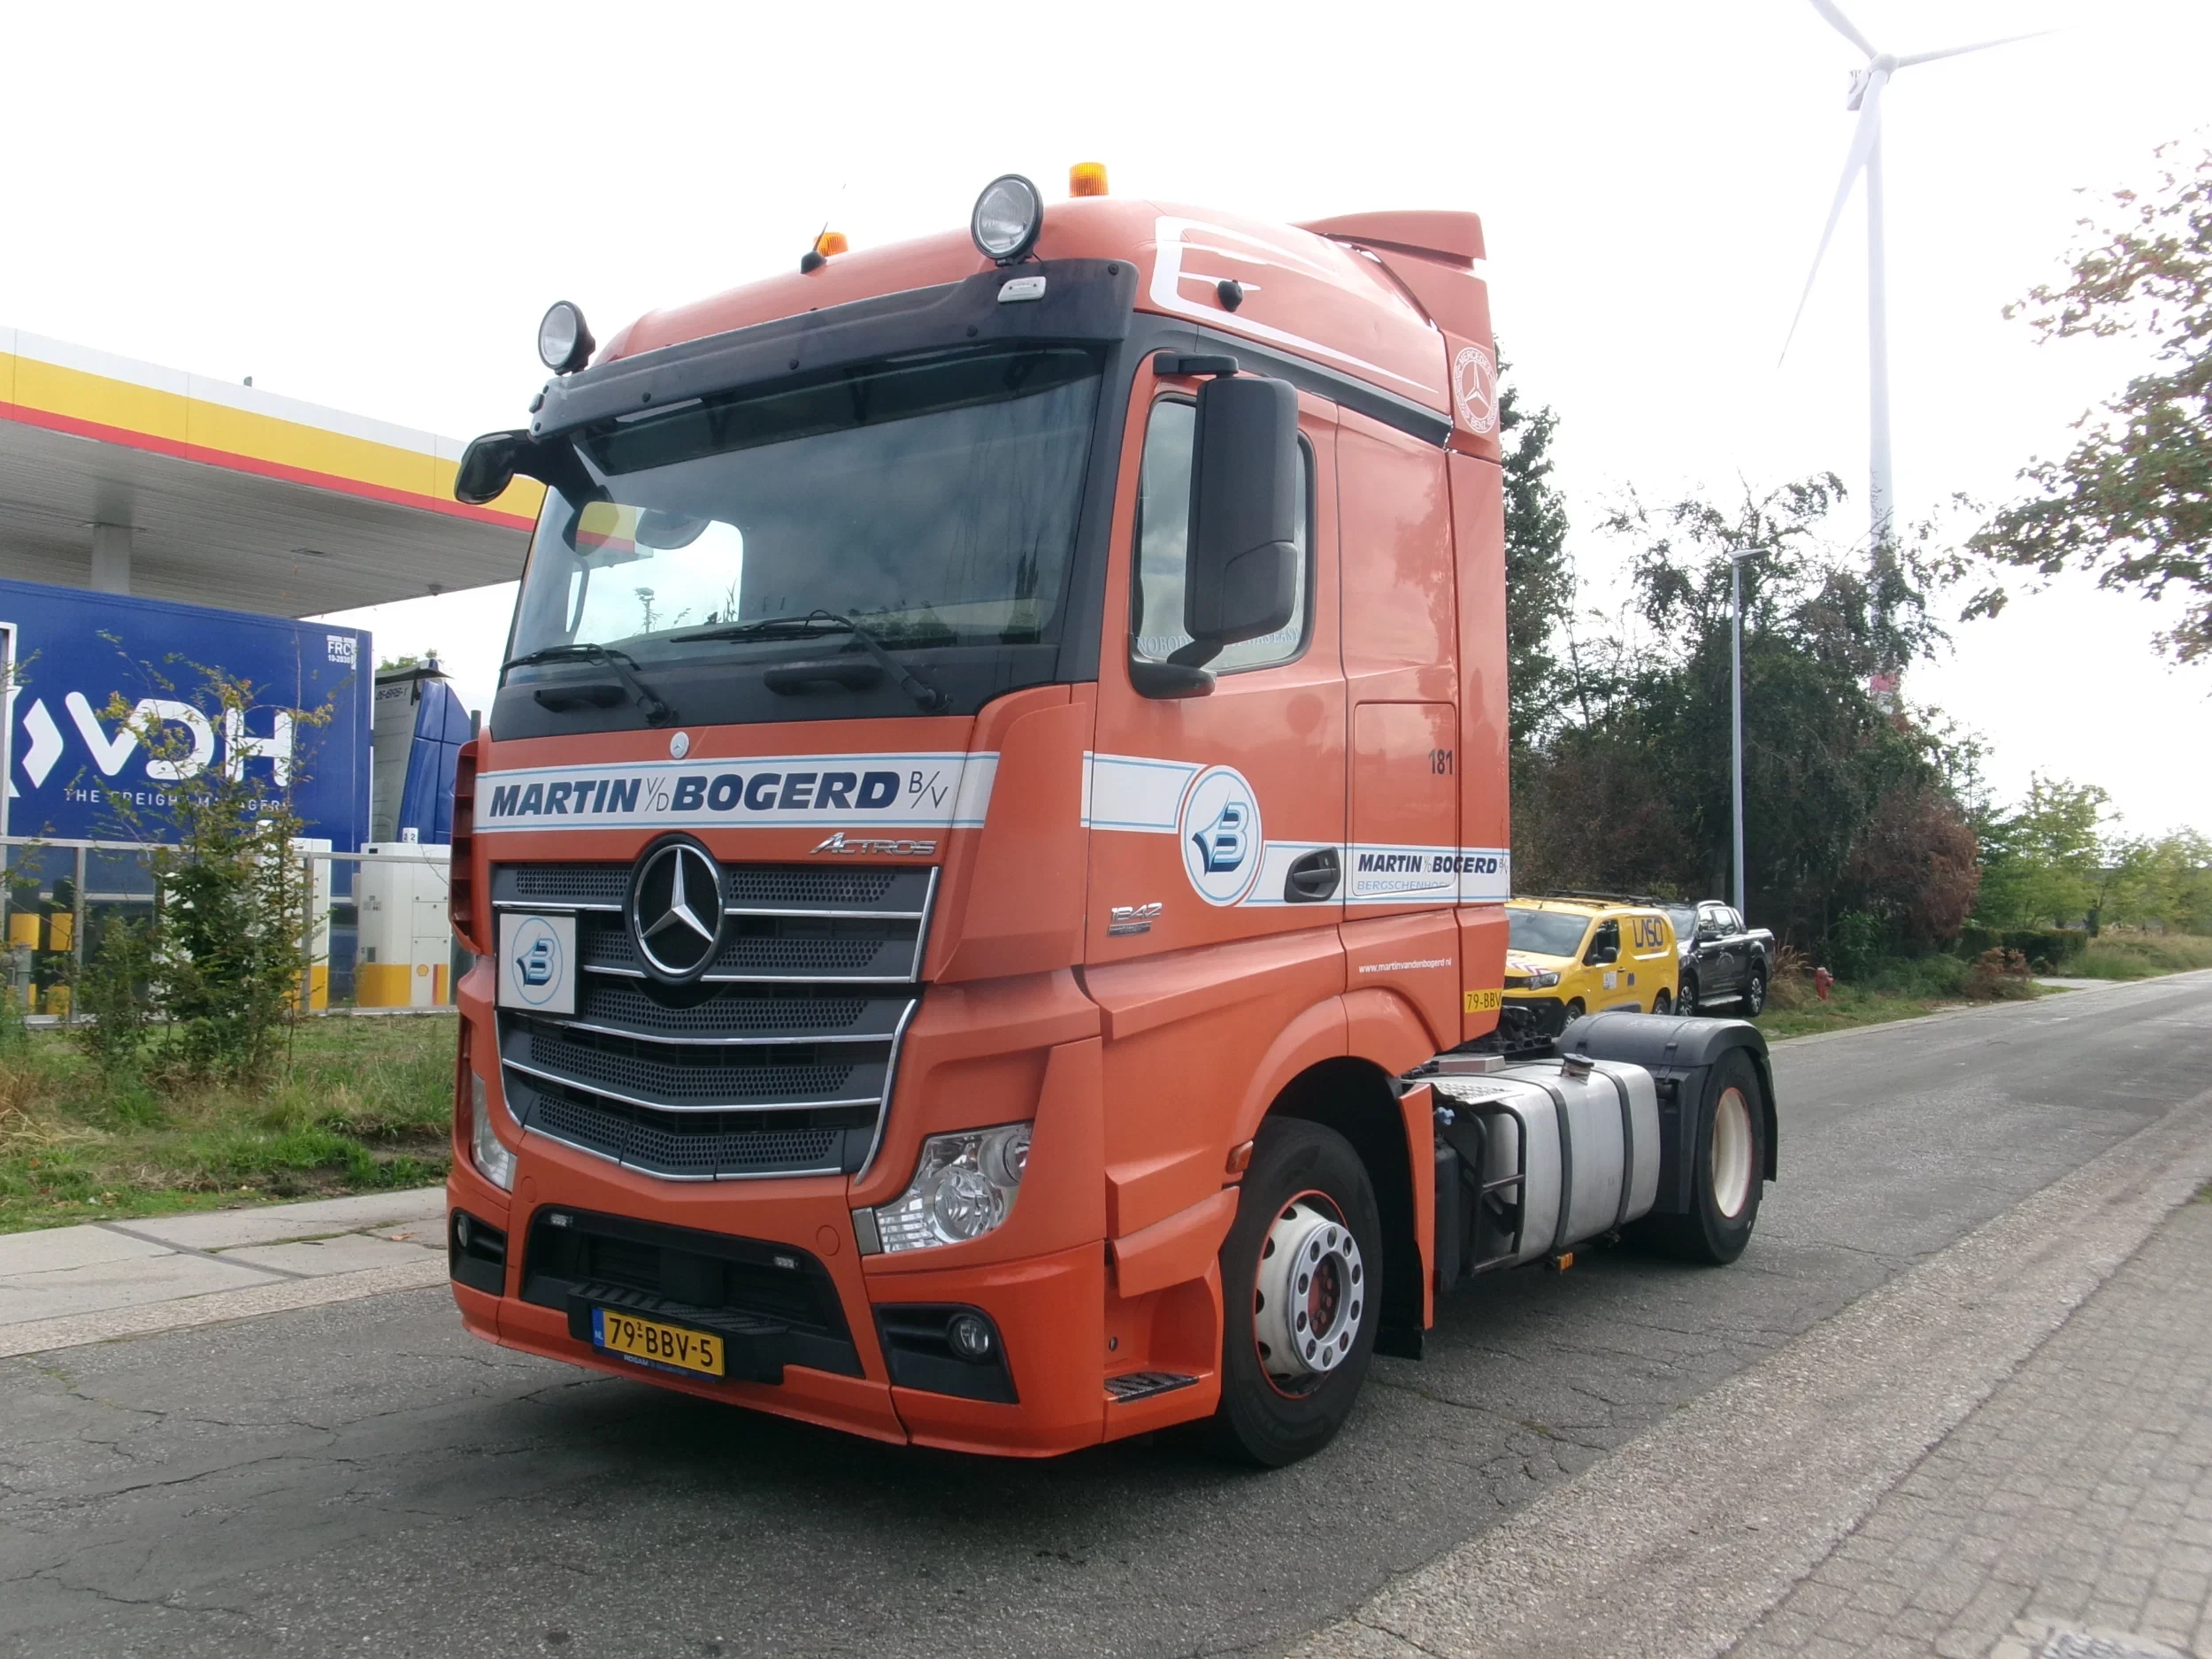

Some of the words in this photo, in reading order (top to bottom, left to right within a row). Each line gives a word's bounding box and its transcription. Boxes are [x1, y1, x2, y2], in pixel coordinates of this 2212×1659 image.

[327, 641, 351, 656] FRC
[1137, 635, 1195, 654] NOBOD
[65, 691, 293, 787] VDH
[1428, 749, 1453, 775] 181
[64, 788, 99, 803] THE
[110, 791, 189, 807] REIGH
[489, 778, 643, 818] MARTIN
[670, 771, 901, 812] BOGERD
[908, 771, 949, 810] B/V
[1358, 854, 1423, 872] MARTIN
[1432, 856, 1498, 874] BOGERD
[595, 1330, 603, 1340] NL
[609, 1317, 713, 1367] 79-BBV-5
